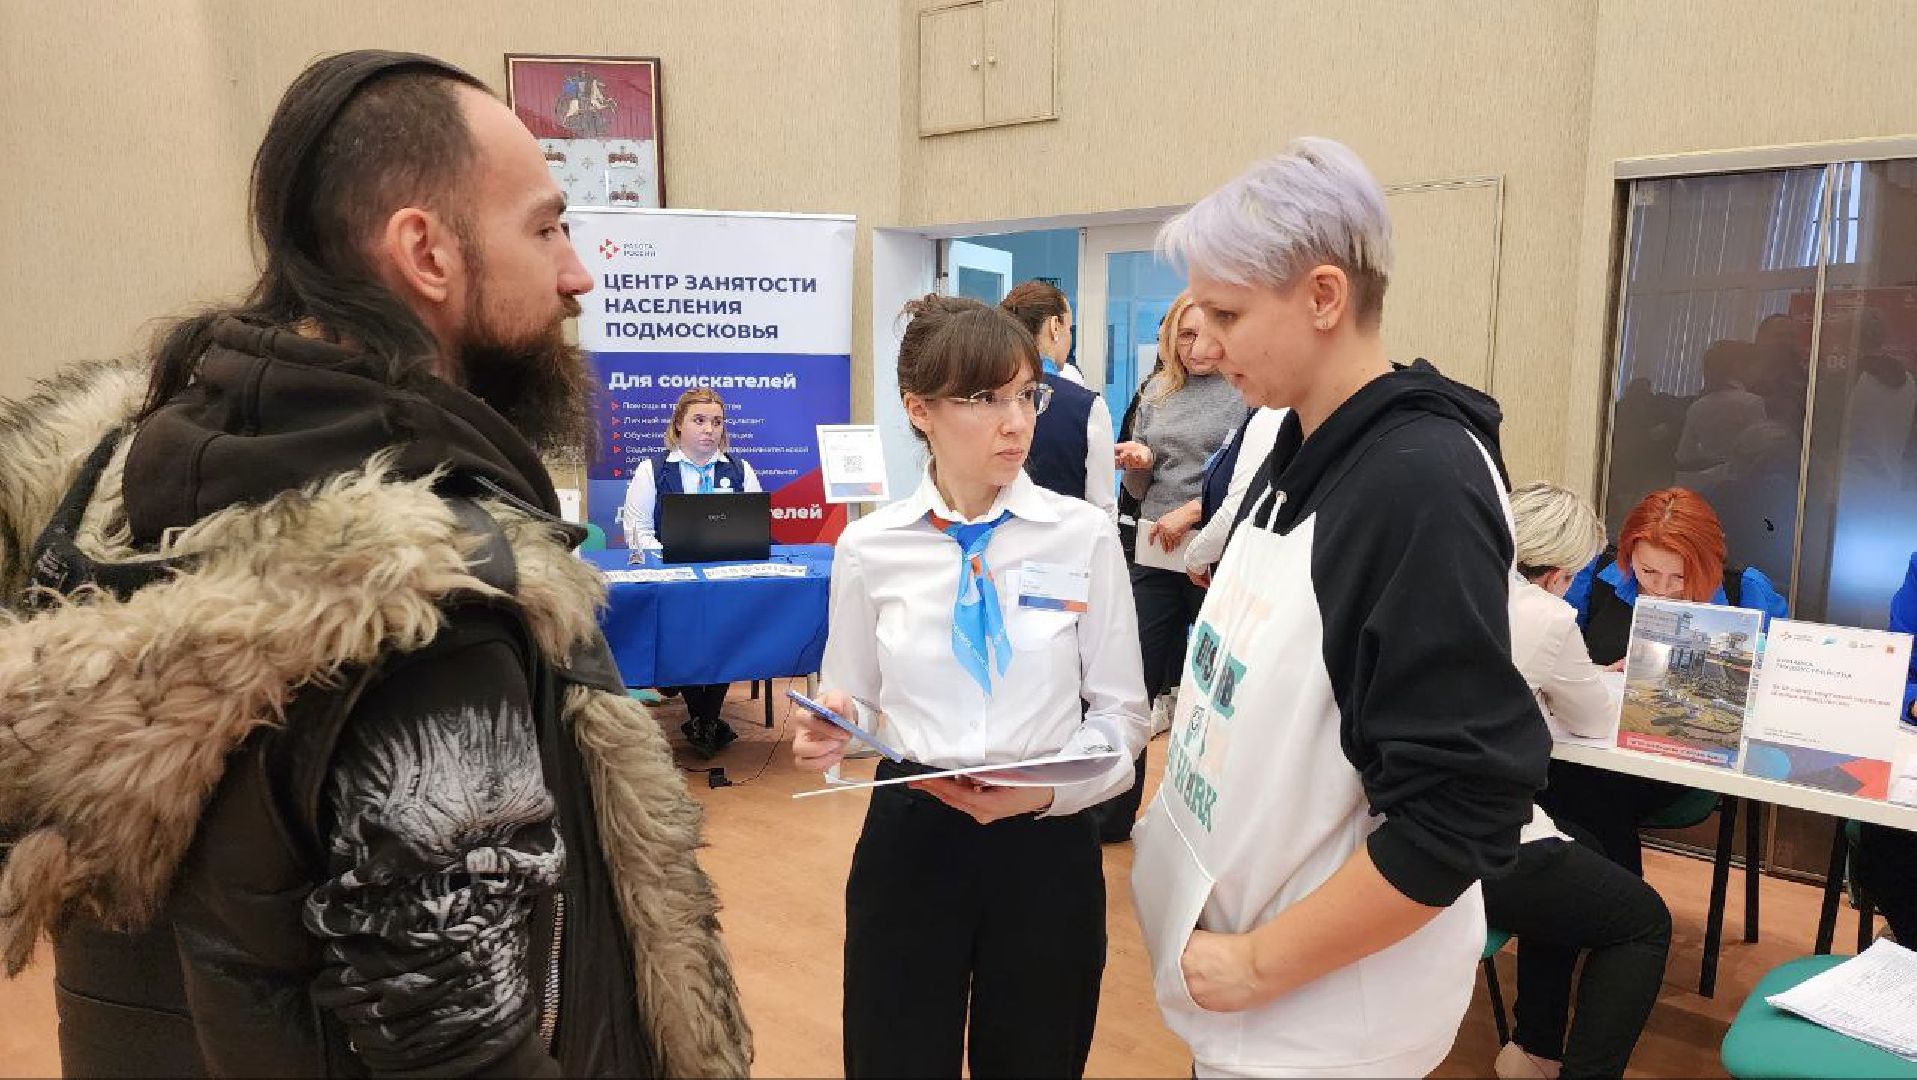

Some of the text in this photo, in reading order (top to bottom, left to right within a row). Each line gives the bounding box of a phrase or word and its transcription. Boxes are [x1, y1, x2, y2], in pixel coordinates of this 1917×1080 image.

[604, 273, 817, 293] ЦЕНТР ЗАНЯТОСТИ
[605, 298, 742, 315] НАСЕЛЕНИЯ
[605, 322, 778, 341] ПОДМОСКОВЬЯ
[608, 372, 797, 391] Для соискателей
